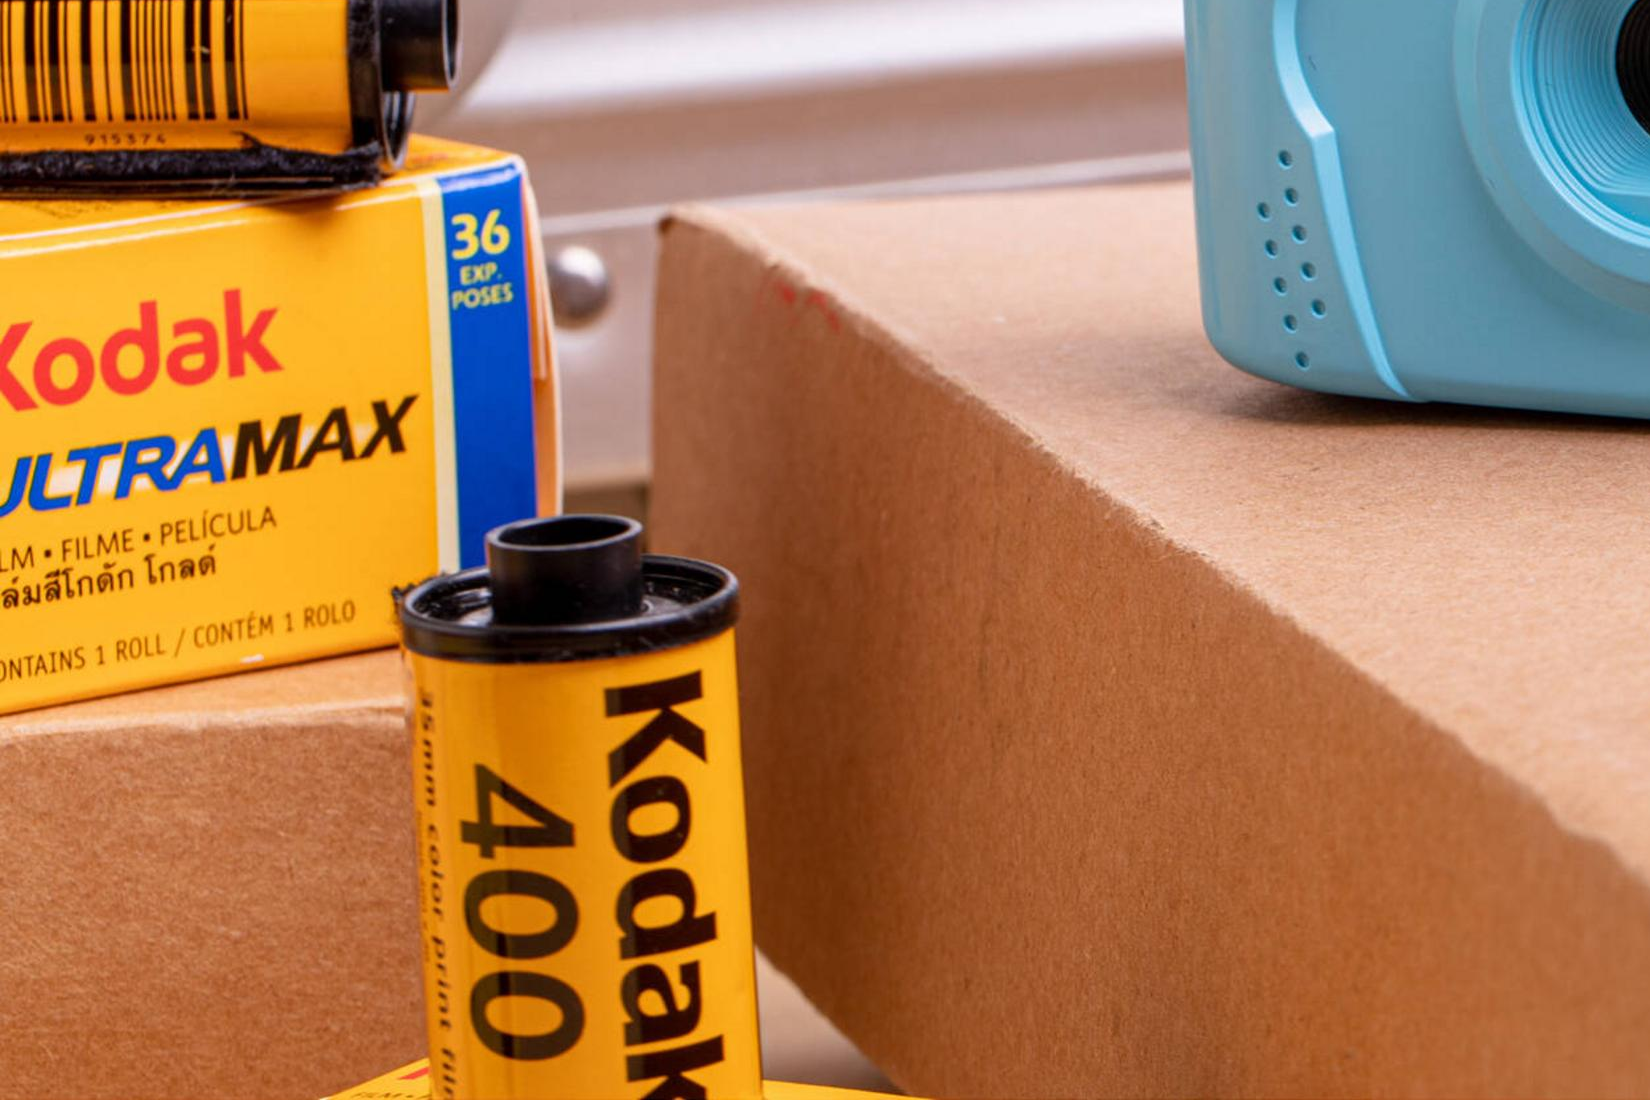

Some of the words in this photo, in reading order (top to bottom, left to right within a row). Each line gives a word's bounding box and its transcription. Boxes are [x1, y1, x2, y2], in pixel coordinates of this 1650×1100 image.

[451, 208, 511, 260] 36
[459, 261, 503, 286] EXP.
[451, 282, 514, 310] POSES
[61, 528, 135, 563] FILME
[159, 506, 278, 547] PELÍCULA
[0, 646, 86, 683] ONTAINS
[96, 645, 105, 665] 1
[115, 633, 166, 663] ROLL
[193, 611, 274, 649] CONTÉM
[285, 613, 294, 633] 1
[303, 600, 356, 629] ROLO
[428, 823, 444, 922] color
[459, 762, 587, 1061] 400
[603, 670, 726, 1100] Kodak
[431, 935, 452, 1030] print
